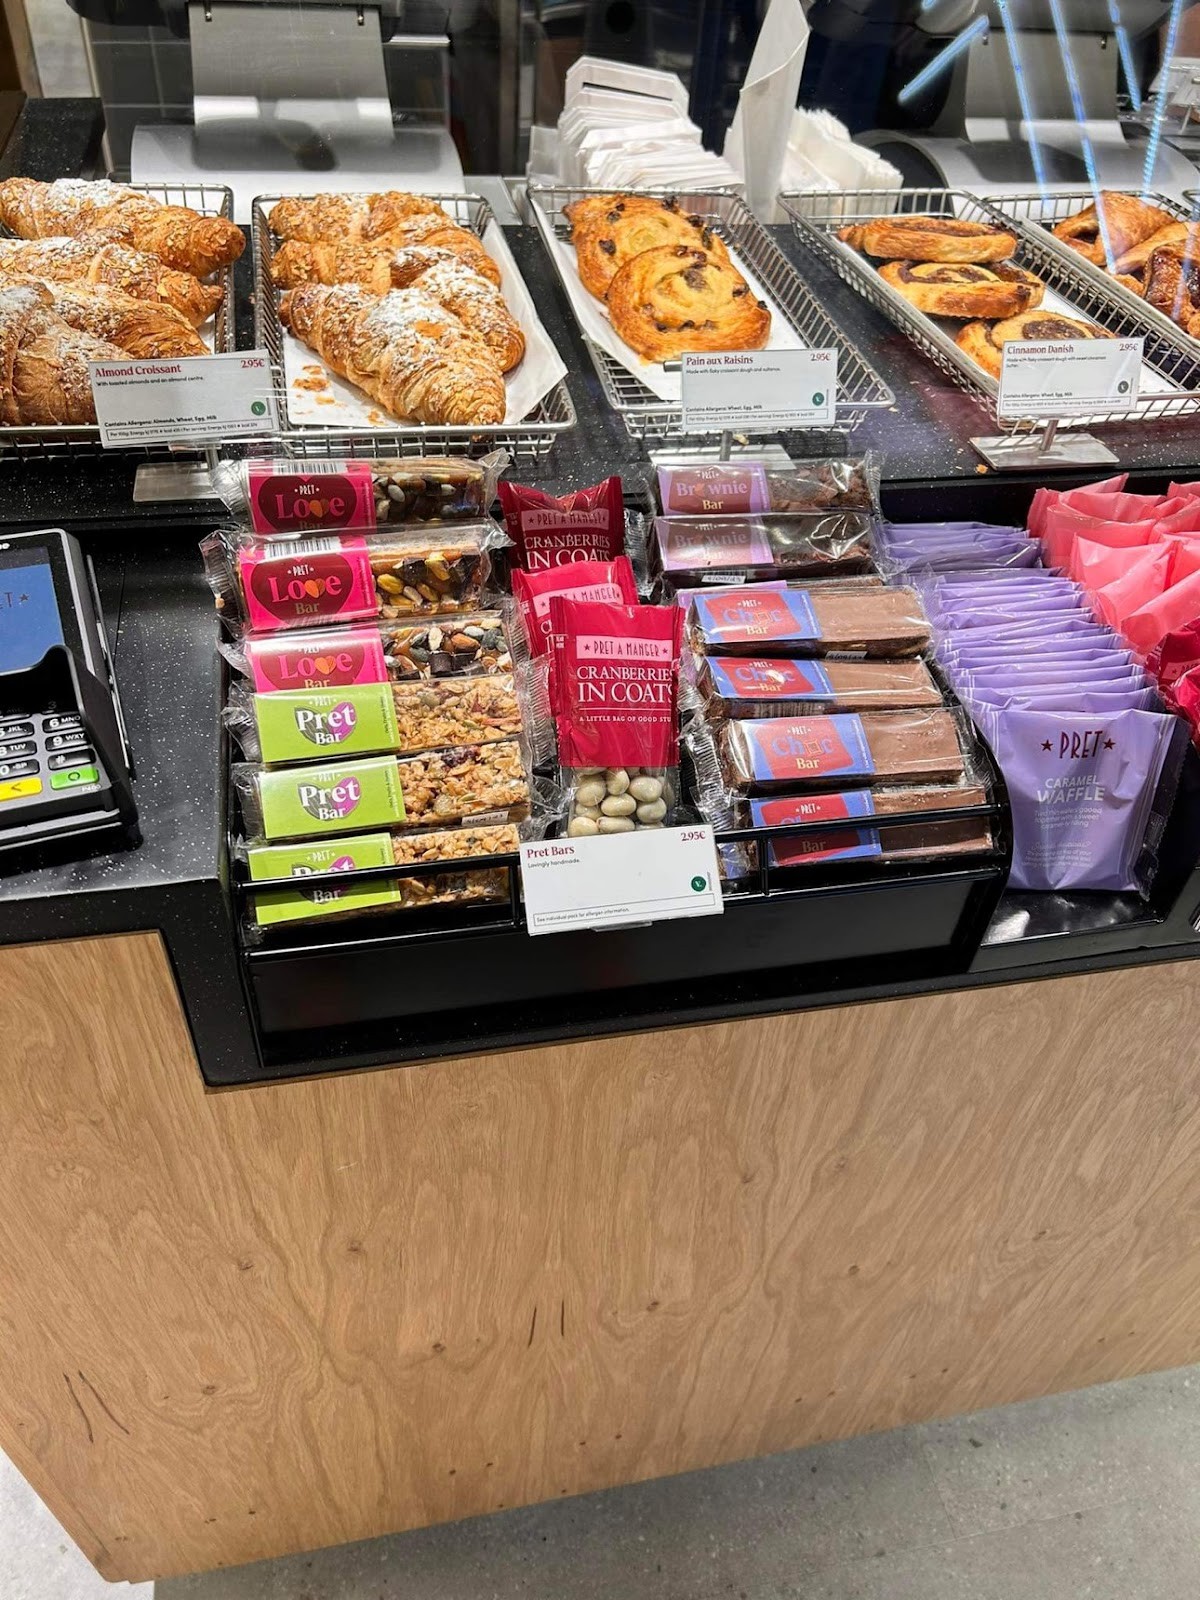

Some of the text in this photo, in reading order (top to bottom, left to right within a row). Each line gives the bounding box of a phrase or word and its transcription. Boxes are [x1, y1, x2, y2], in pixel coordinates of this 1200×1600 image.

[1007, 344, 1074, 354] Cinnamon Danish
[686, 356, 705, 366] Pain
[724, 355, 753, 365] Raisins
[95, 364, 181, 378] Almond Croissant
[300, 484, 315, 495] PRET
[702, 500, 724, 510] Bar
[537, 512, 557, 526] PRET
[561, 514, 566, 523] A
[524, 534, 610, 549] CRANBERRIES
[526, 551, 550, 570] IN
[293, 565, 310, 576] PRET
[295, 603, 320, 615] Bar
[746, 626, 769, 635] Bar
[594, 641, 659, 657] PRET A MANGER
[304, 678, 330, 688] Bar
[760, 684, 782, 692] Bar
[578, 682, 607, 702] IN
[49, 719, 60, 727] 6
[296, 705, 356, 731] Pret
[792, 726, 807, 734] PRET
[53, 736, 62, 746] 9
[314, 732, 342, 745] Bar
[1060, 731, 1103, 759] PRET
[796, 758, 820, 769] Bar
[0, 766, 9, 775] 0
[1045, 775, 1099, 789] CARAMEL
[300, 779, 360, 807] Pret
[1036, 787, 1105, 805] WAFFLE
[319, 807, 346, 820] Bar
[801, 804, 816, 814] PRET
[802, 840, 826, 852] Bar
[312, 850, 330, 861] PRET
[527, 846, 574, 859] Pret Bars
[528, 858, 580, 869] Lovingly handmade.
[313, 889, 341, 903] Bar
